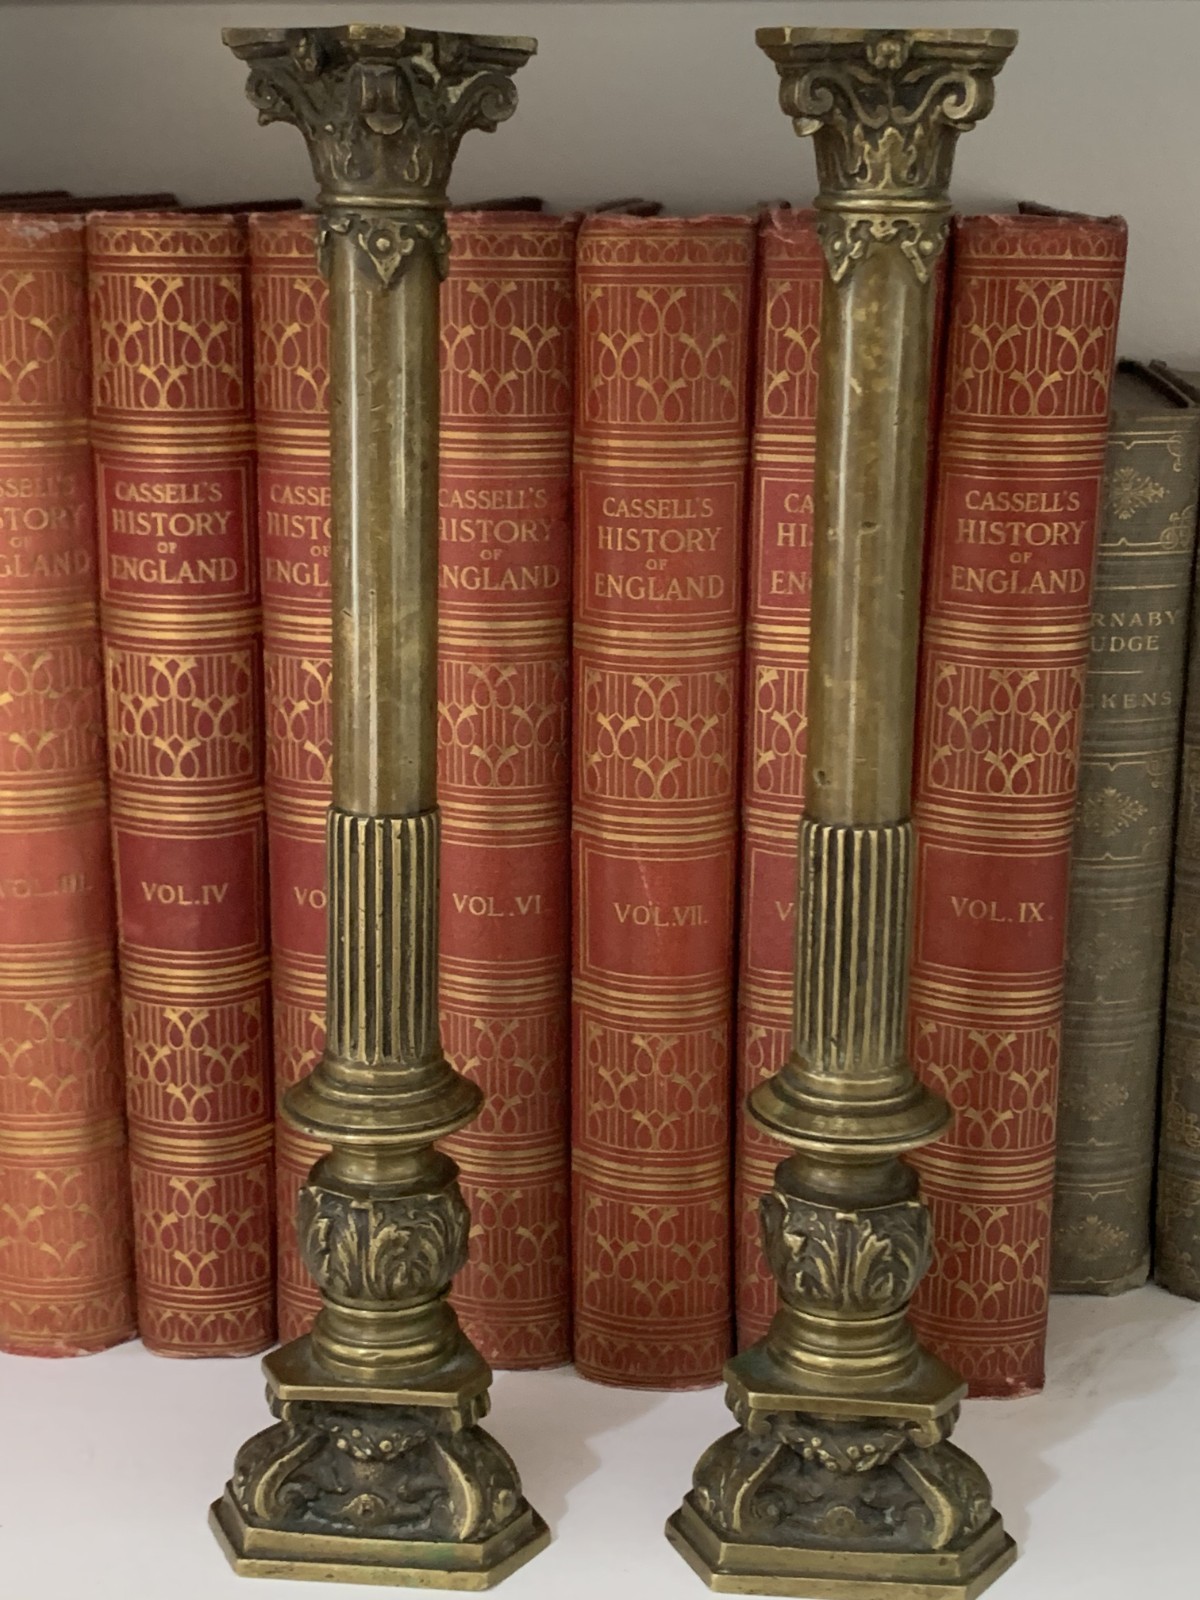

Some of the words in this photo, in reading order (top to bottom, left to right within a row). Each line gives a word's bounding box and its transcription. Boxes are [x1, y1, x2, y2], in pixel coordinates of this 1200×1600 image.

[115, 481, 222, 504] CASSELL'S
[439, 487, 548, 510] CASSELL'S
[965, 489, 1080, 512] CASSELL'S
[602, 496, 714, 519] CASSELL'S
[112, 508, 232, 537] HISTORY
[957, 518, 1087, 546] HISTORY
[157, 541, 178, 554] OF
[598, 525, 722, 553] HISTORY
[480, 548, 503, 561] OF
[645, 558, 668, 571] OF
[1009, 551, 1033, 564] OF
[111, 555, 237, 584] ENGLAND
[439, 564, 559, 591] NGLAND
[951, 564, 1085, 594] ENGLAND
[594, 572, 724, 601] ENGLAND
